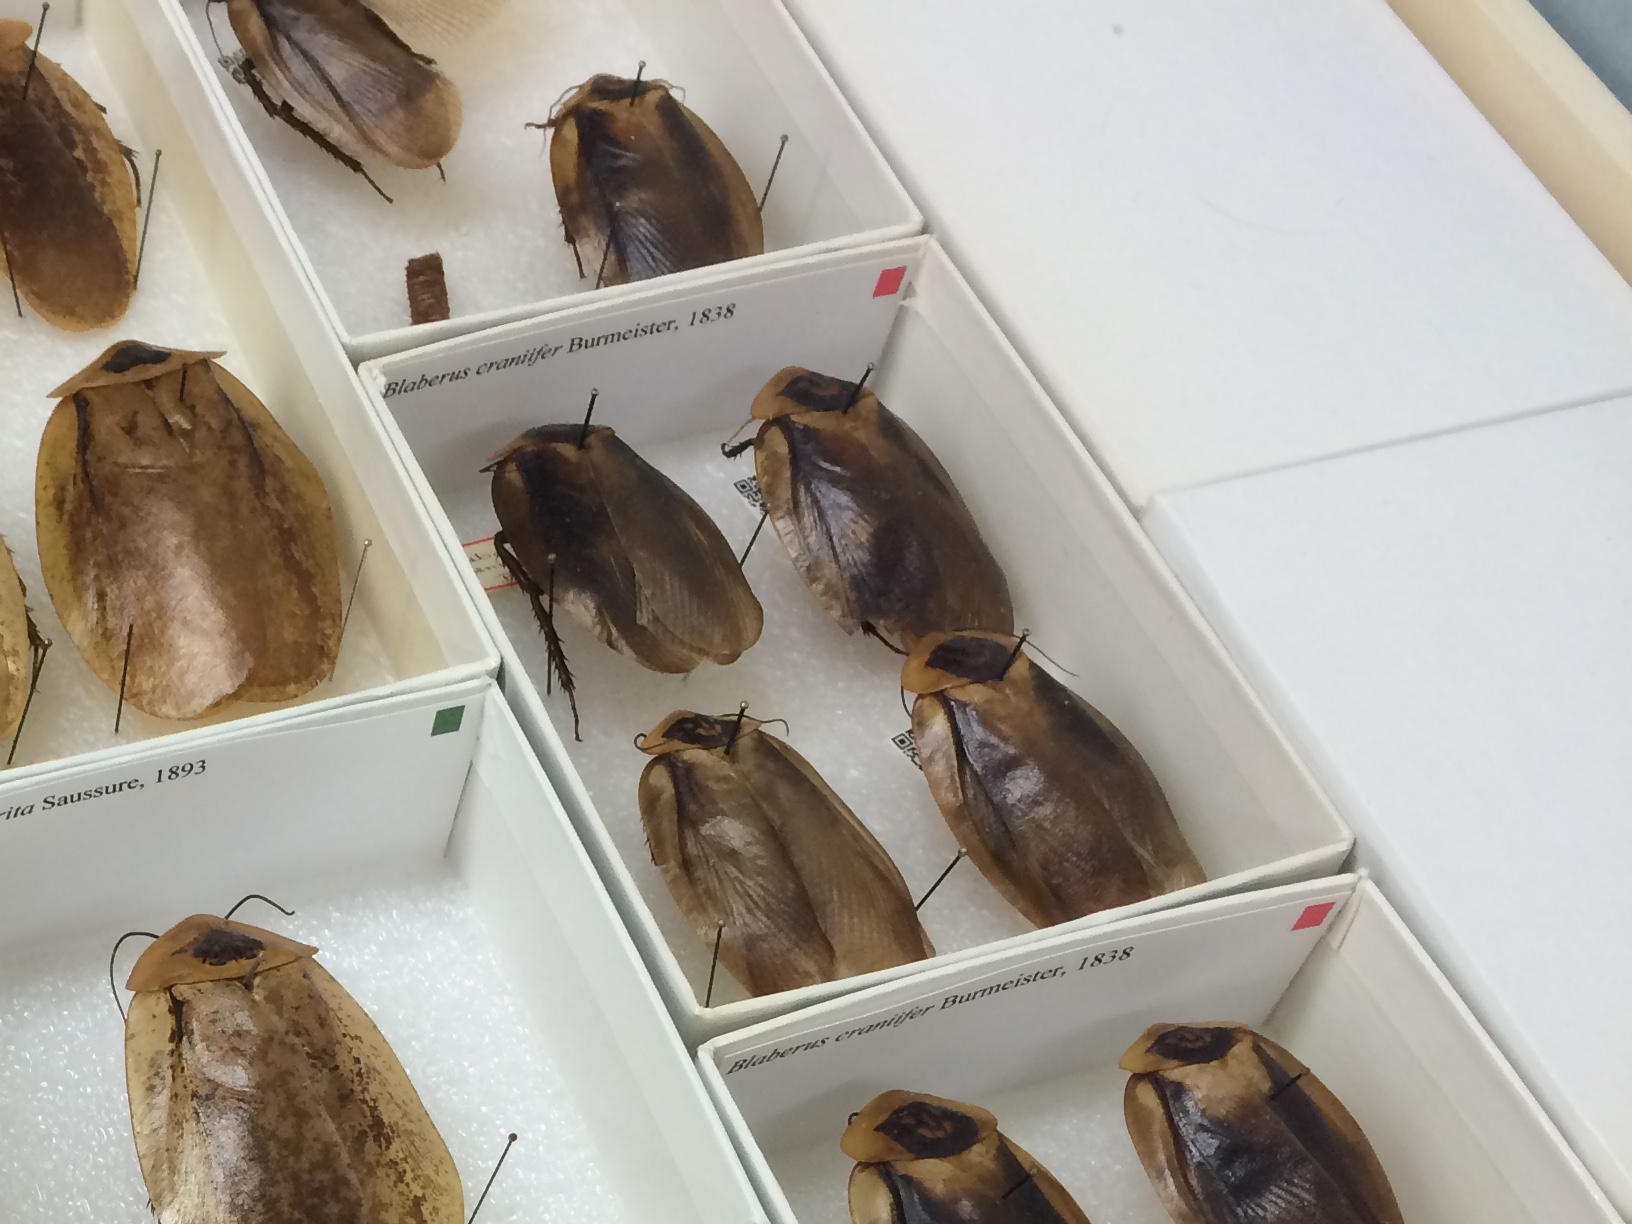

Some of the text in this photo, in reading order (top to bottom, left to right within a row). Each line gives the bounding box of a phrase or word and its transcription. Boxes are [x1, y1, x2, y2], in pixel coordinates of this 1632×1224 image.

[383, 303, 737, 400] Blaberus craniifer Burmeister, 1838
[42, 778, 145, 811] Saussure,
[155, 759, 207, 784] 1893
[725, 946, 1135, 1076] Blaberus craniifer Burmeister, 1838
